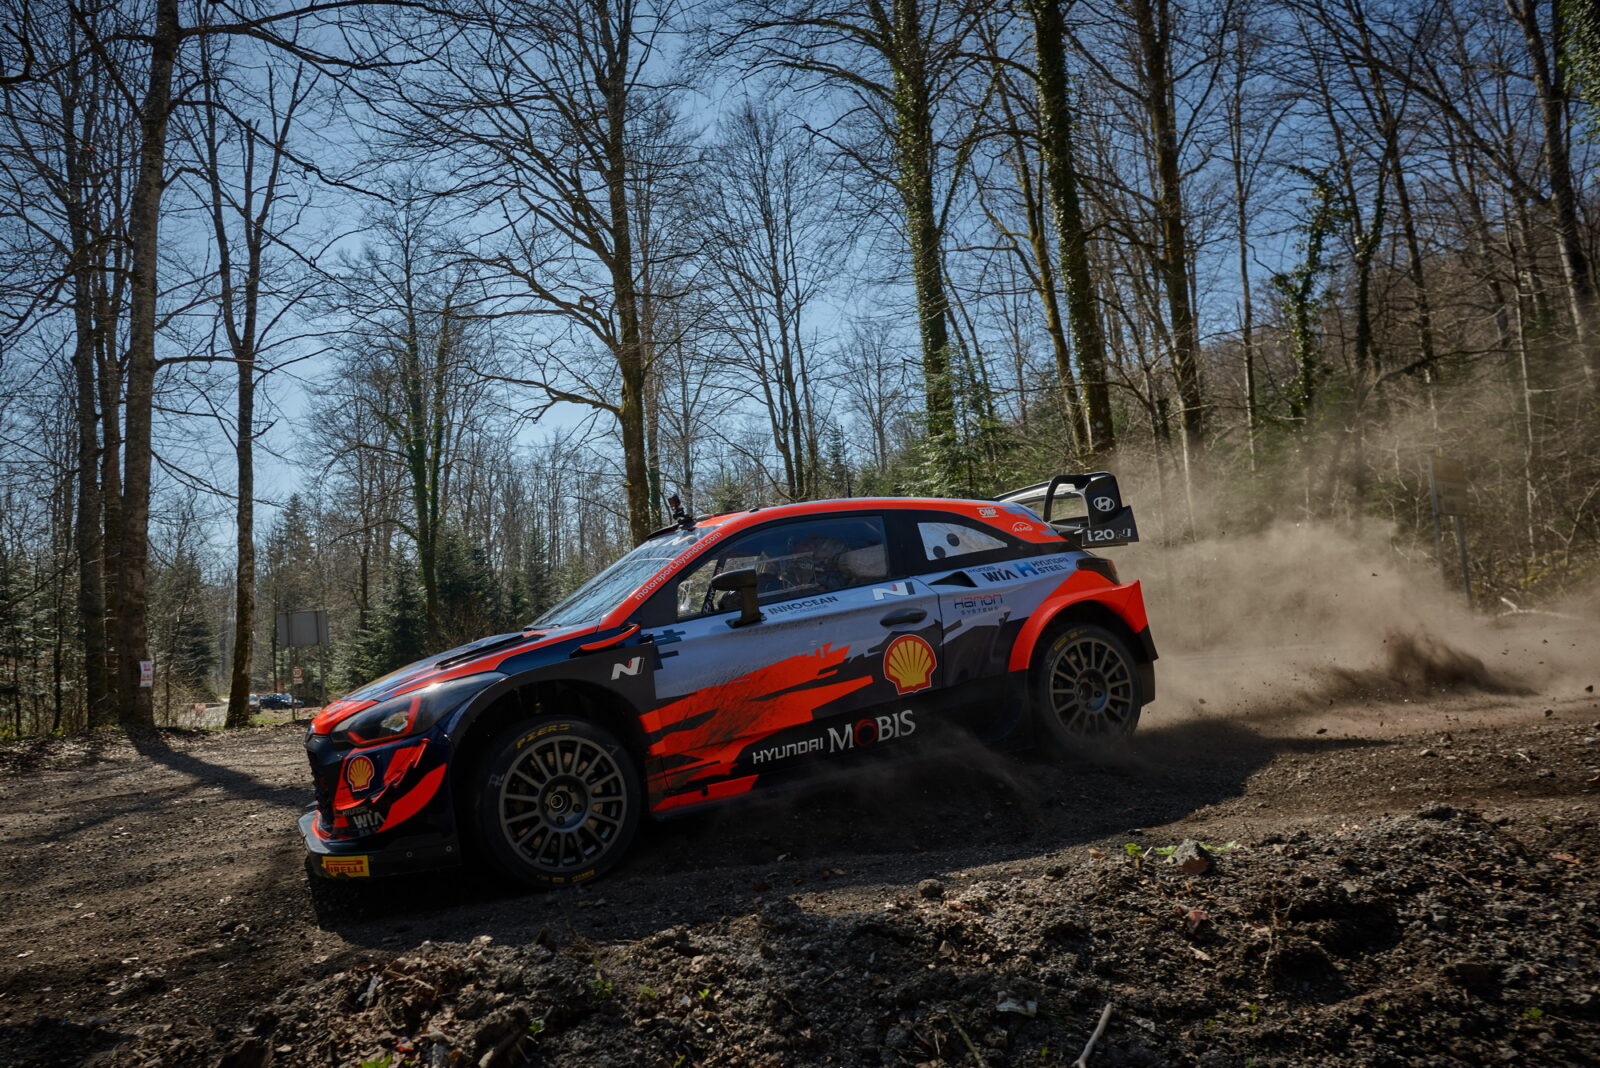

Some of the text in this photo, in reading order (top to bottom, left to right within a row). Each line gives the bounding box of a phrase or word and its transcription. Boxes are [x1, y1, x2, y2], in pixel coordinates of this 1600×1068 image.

[1087, 528, 1115, 542] i20
[634, 532, 722, 600] motorsport.hyundai.com
[1031, 557, 1069, 568] HYUNDAI
[1037, 564, 1067, 574] STEEL
[768, 596, 839, 615] INNOCEAN
[961, 607, 999, 615] SYSTEMS
[752, 709, 917, 765] HYUNDAI MOBIS
